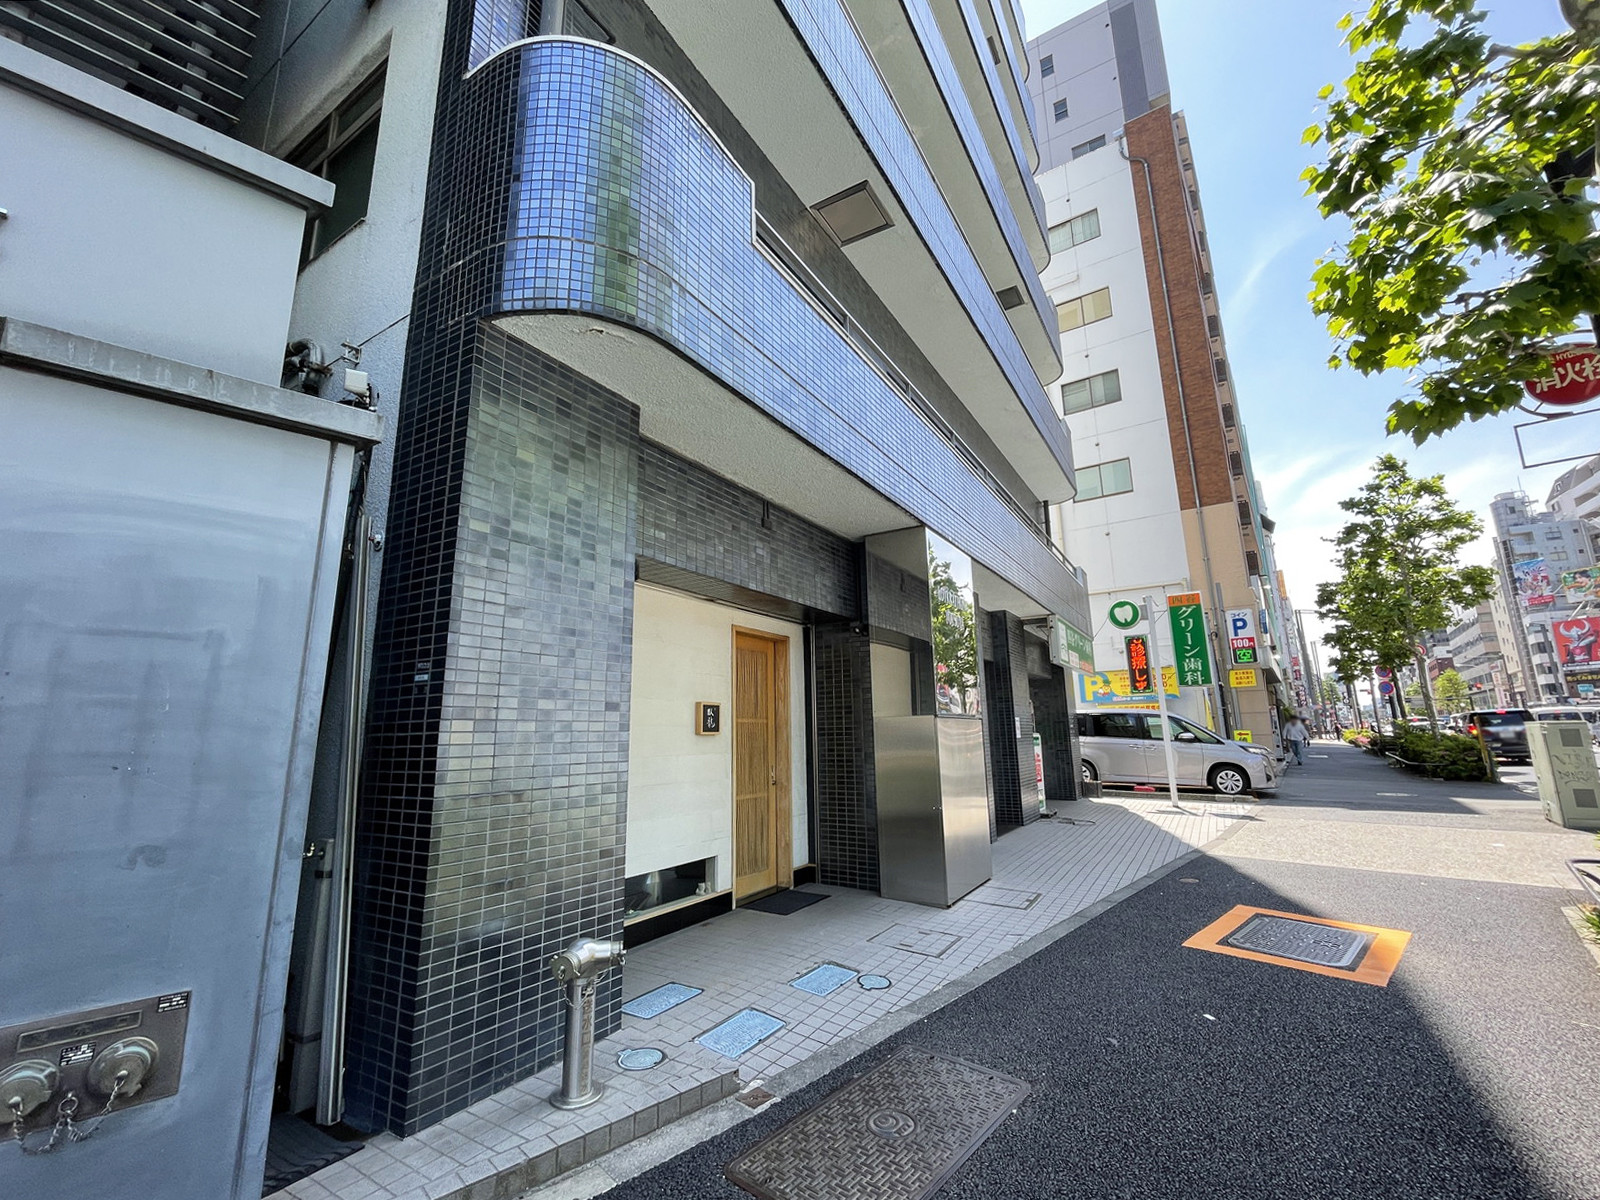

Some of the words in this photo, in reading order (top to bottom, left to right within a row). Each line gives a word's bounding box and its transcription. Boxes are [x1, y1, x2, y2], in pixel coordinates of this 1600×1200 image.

[1177, 605, 1205, 685] グリーン歯科
[1231, 617, 1248, 637] P
